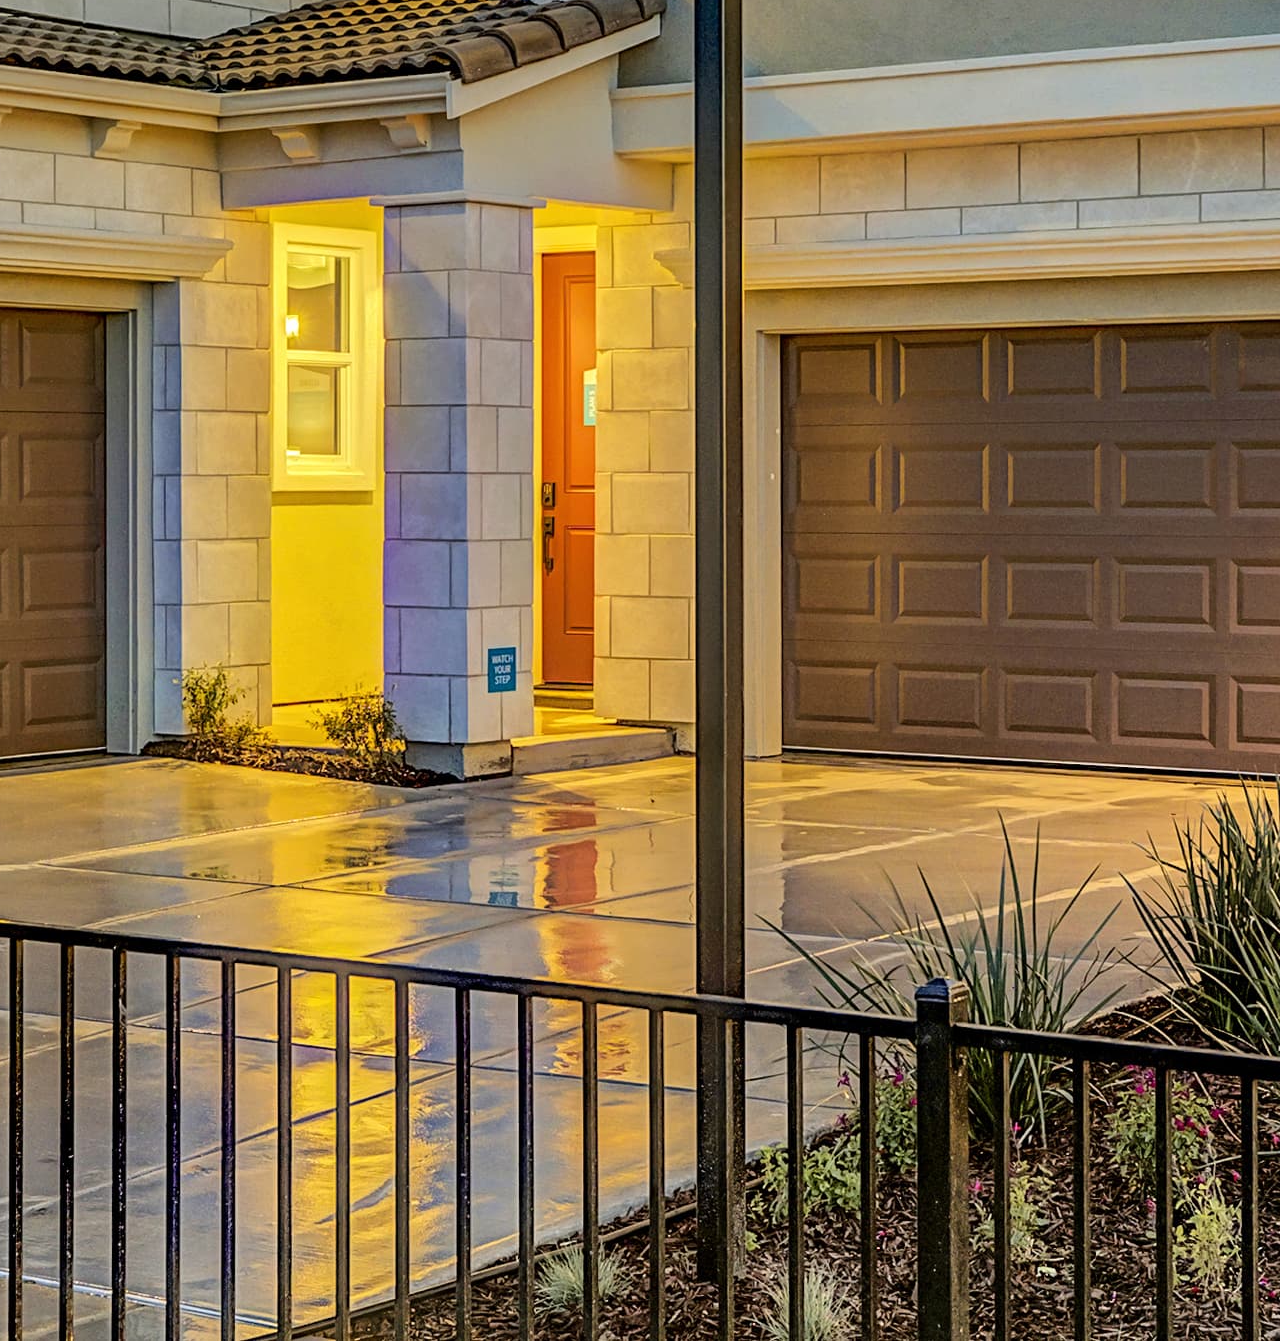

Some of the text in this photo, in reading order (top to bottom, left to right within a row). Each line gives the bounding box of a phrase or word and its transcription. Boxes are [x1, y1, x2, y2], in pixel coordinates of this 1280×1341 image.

[491, 654, 514, 664] WATCH
[494, 665, 511, 674] YOUR
[494, 675, 511, 685] STEP
